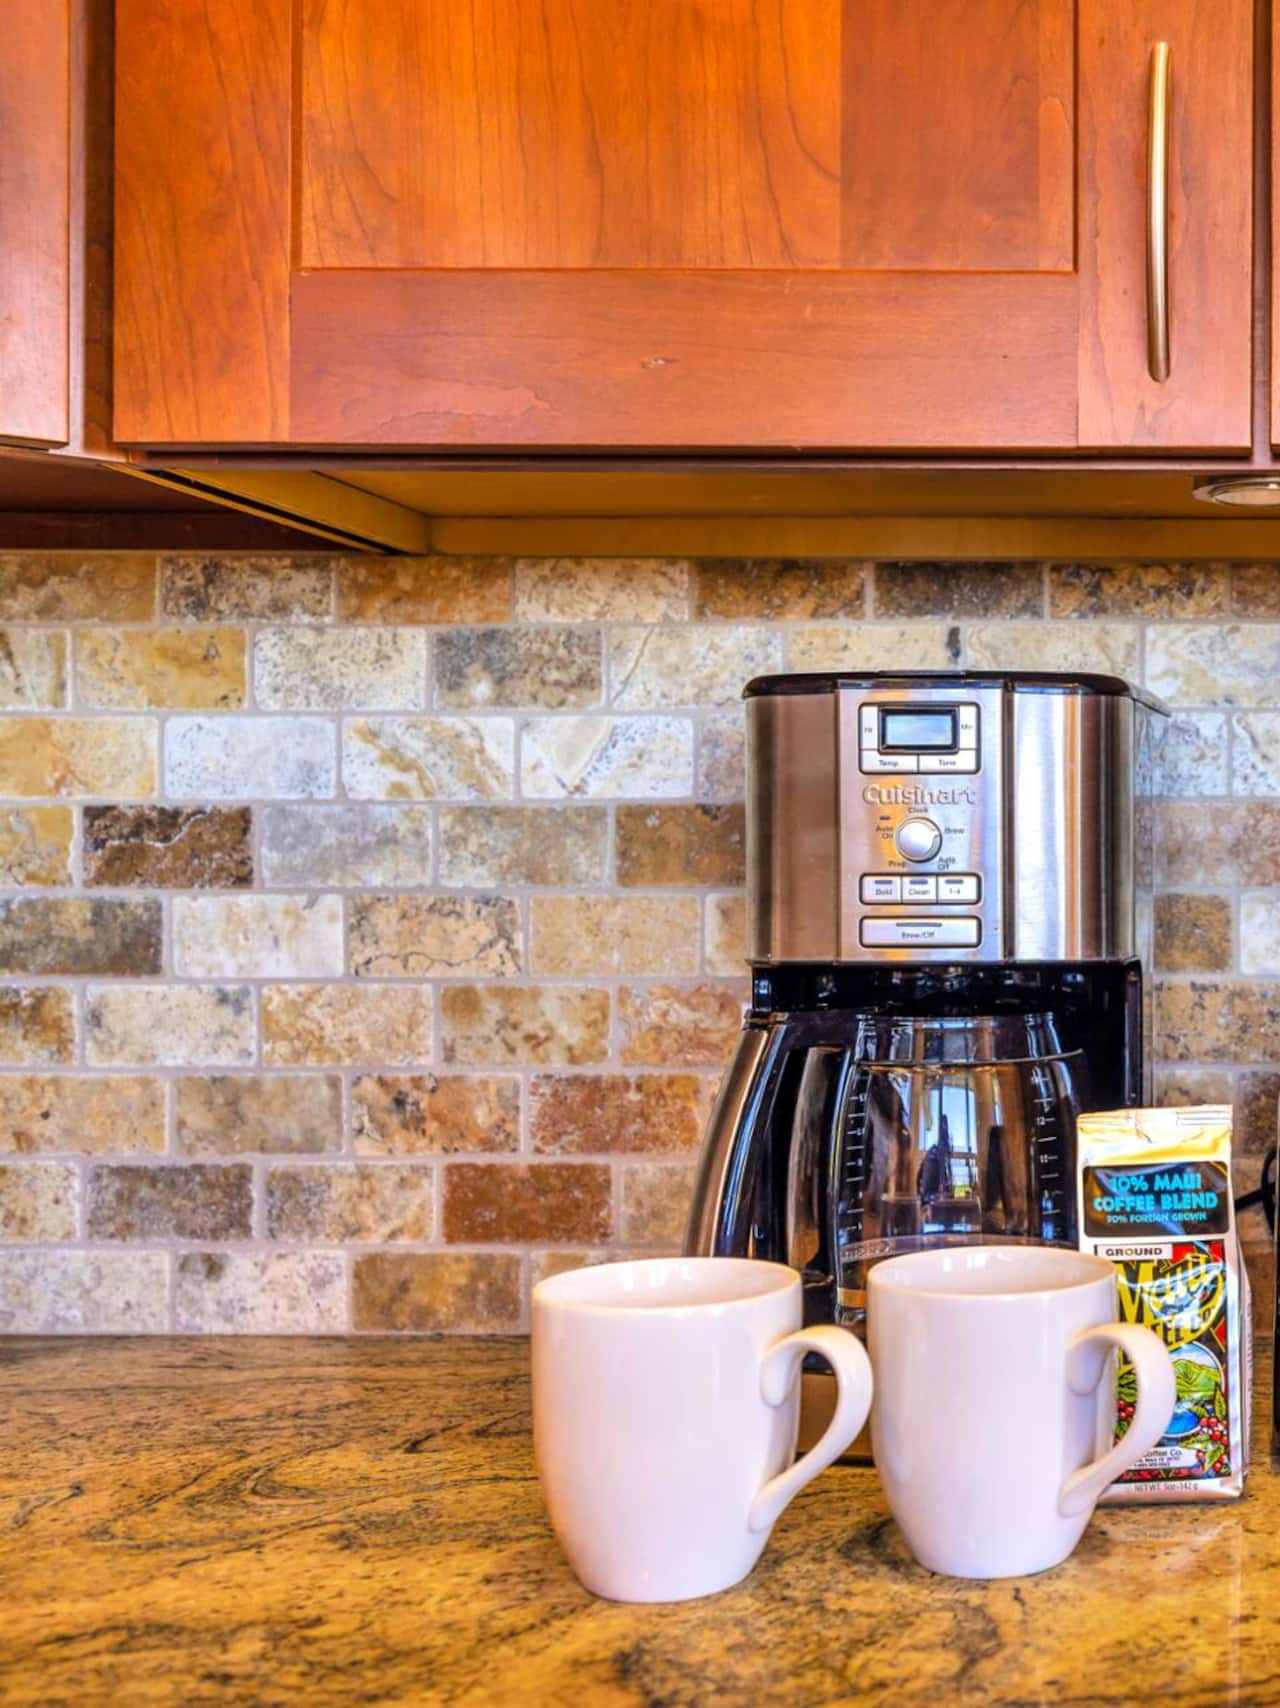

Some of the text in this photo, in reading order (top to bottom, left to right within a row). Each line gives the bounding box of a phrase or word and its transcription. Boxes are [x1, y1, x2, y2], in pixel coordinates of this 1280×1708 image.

[862, 784, 977, 806] Cuisinart
[1109, 1172, 1202, 1193] 10% MAUI
[1092, 1191, 1218, 1213] COFFEE BLEND
[1129, 1212, 1169, 1223] FOREIGN
[1171, 1211, 1207, 1222] GROWN
[1105, 1246, 1163, 1257] GROUND
